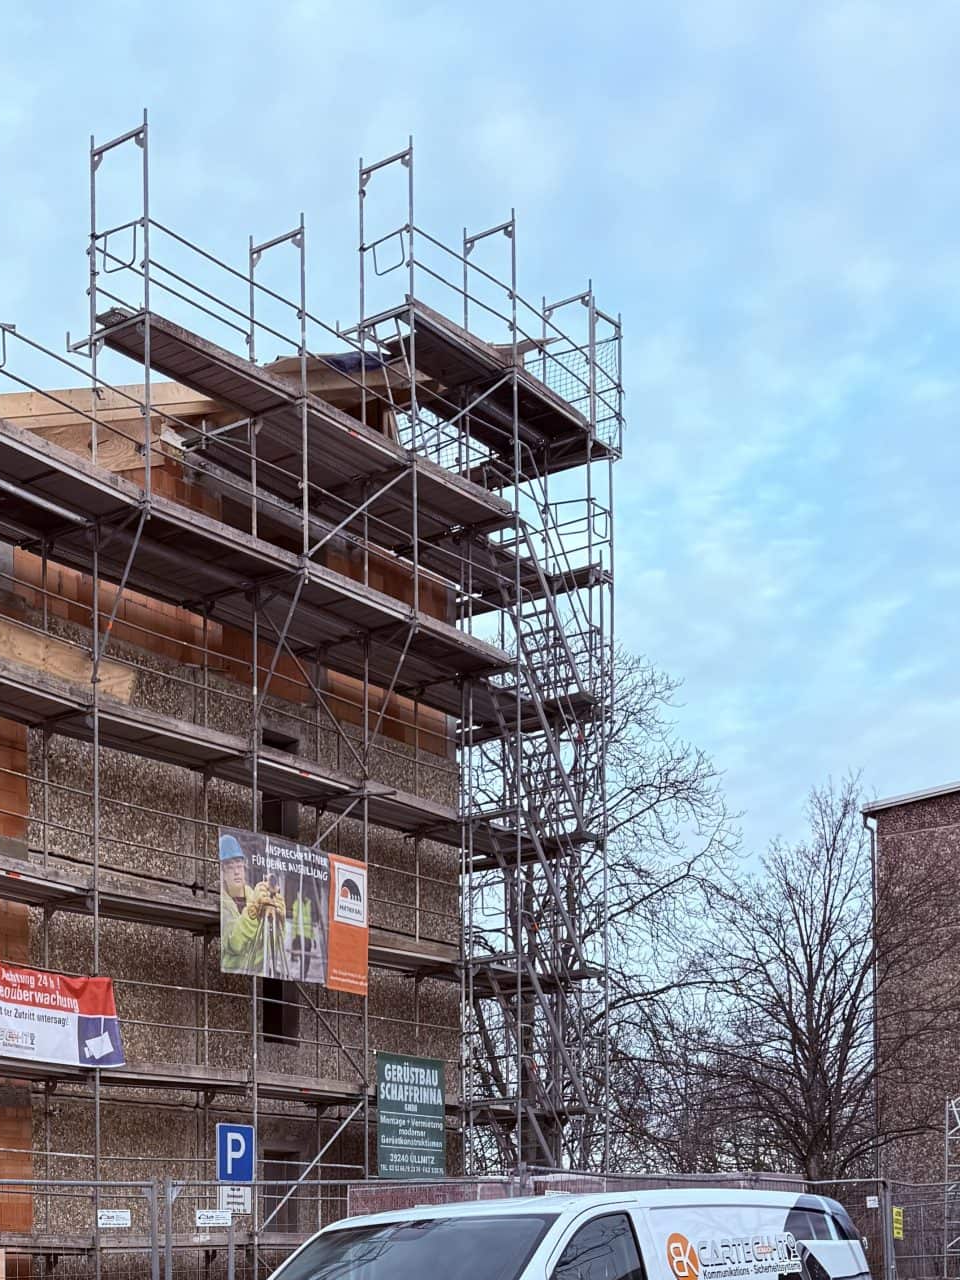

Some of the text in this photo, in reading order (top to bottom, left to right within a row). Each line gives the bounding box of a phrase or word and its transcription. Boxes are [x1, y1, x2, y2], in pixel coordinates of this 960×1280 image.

[1, 967, 35, 988] Achtung
[38, 974, 48, 987] 24
[14, 1008, 35, 1020] Zutritt
[384, 1062, 438, 1087] GERÜSTBAU
[380, 1082, 443, 1105] SCHAFFRINNA
[227, 1132, 246, 1175] P
[703, 1266, 750, 1280] Kommunikations
